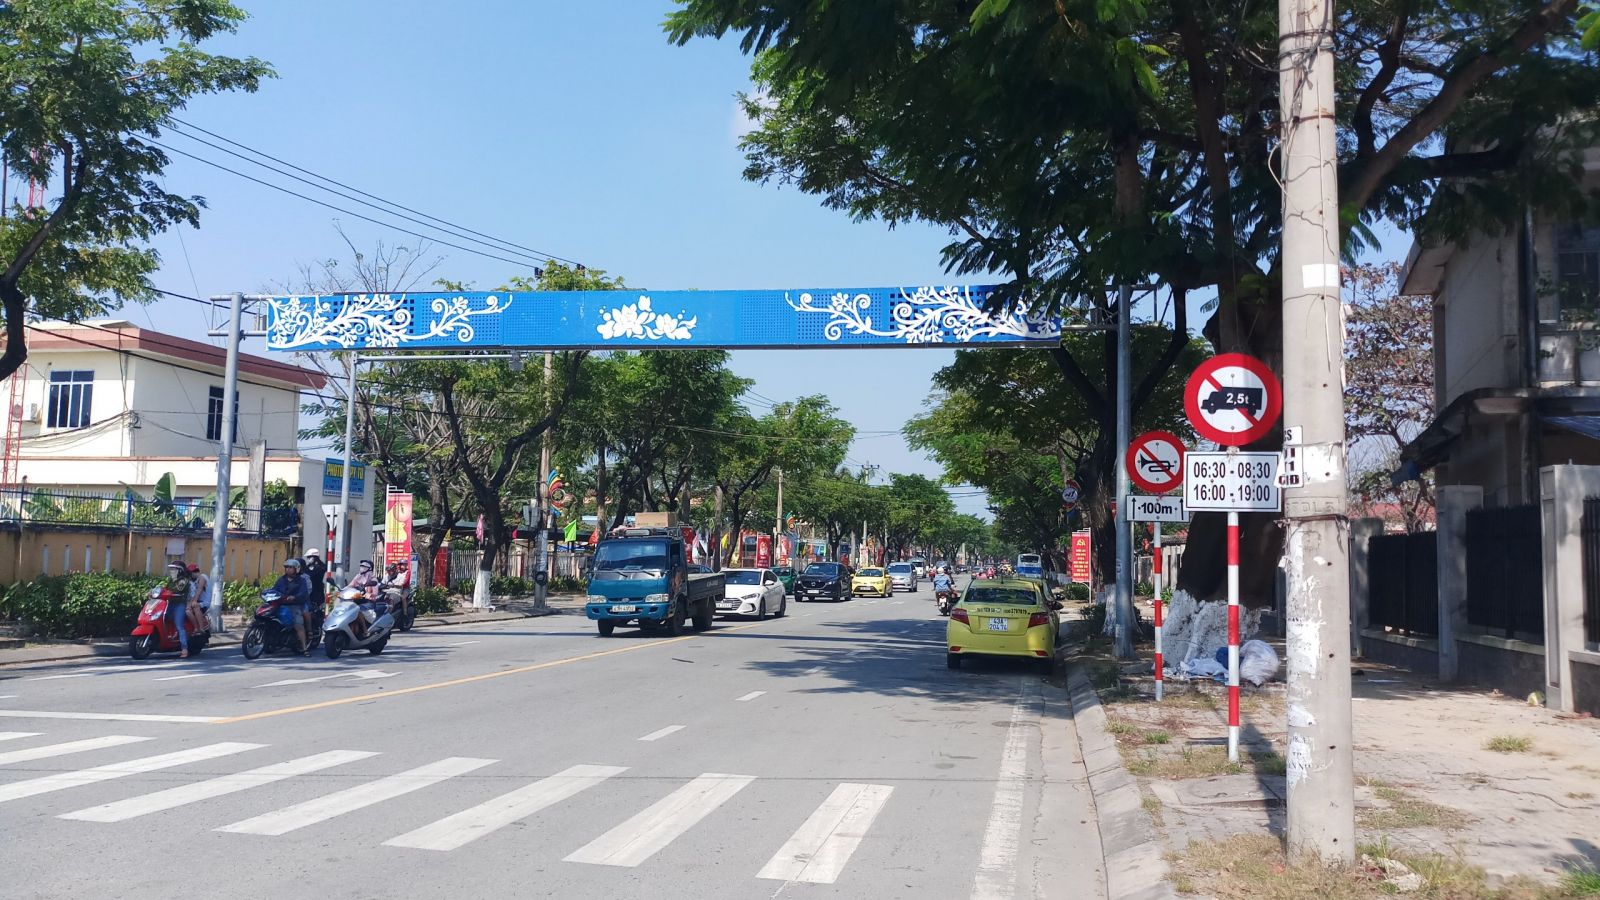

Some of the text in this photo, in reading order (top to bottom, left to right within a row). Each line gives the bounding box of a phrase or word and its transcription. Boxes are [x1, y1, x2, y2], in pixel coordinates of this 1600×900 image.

[1225, 392, 1249, 406] 2,5t
[1193, 461, 1226, 479] 06:30
[1237, 461, 1271, 479] 08:30
[1193, 486, 1226, 502] 16:00
[1237, 486, 1271, 502] 19:00
[1141, 502, 1173, 515] 100m
